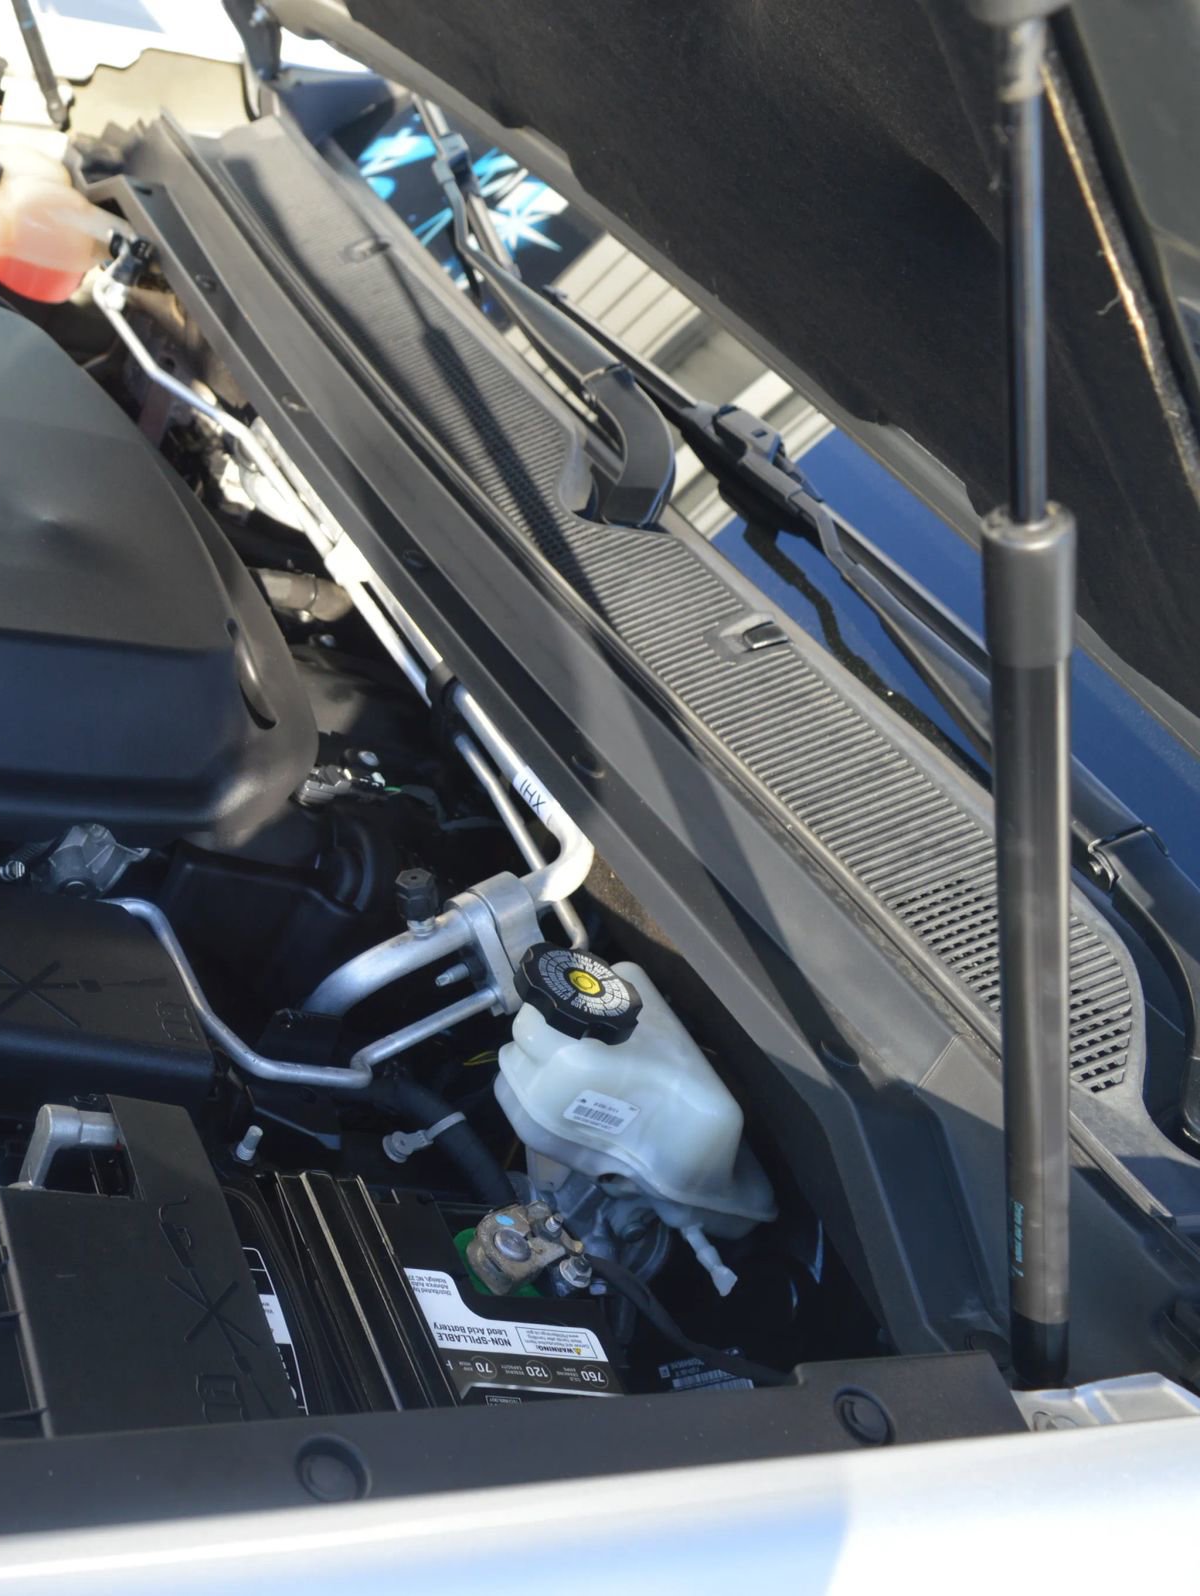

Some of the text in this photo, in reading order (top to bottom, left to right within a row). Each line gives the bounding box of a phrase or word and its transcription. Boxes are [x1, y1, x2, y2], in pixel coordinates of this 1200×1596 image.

[433, 1322, 508, 1337] Lead Acid Battery
[436, 1332, 512, 1347] NON-SPILLABLE
[475, 1362, 493, 1373] 70
[525, 1366, 549, 1378] 120
[580, 1371, 606, 1383] 760
